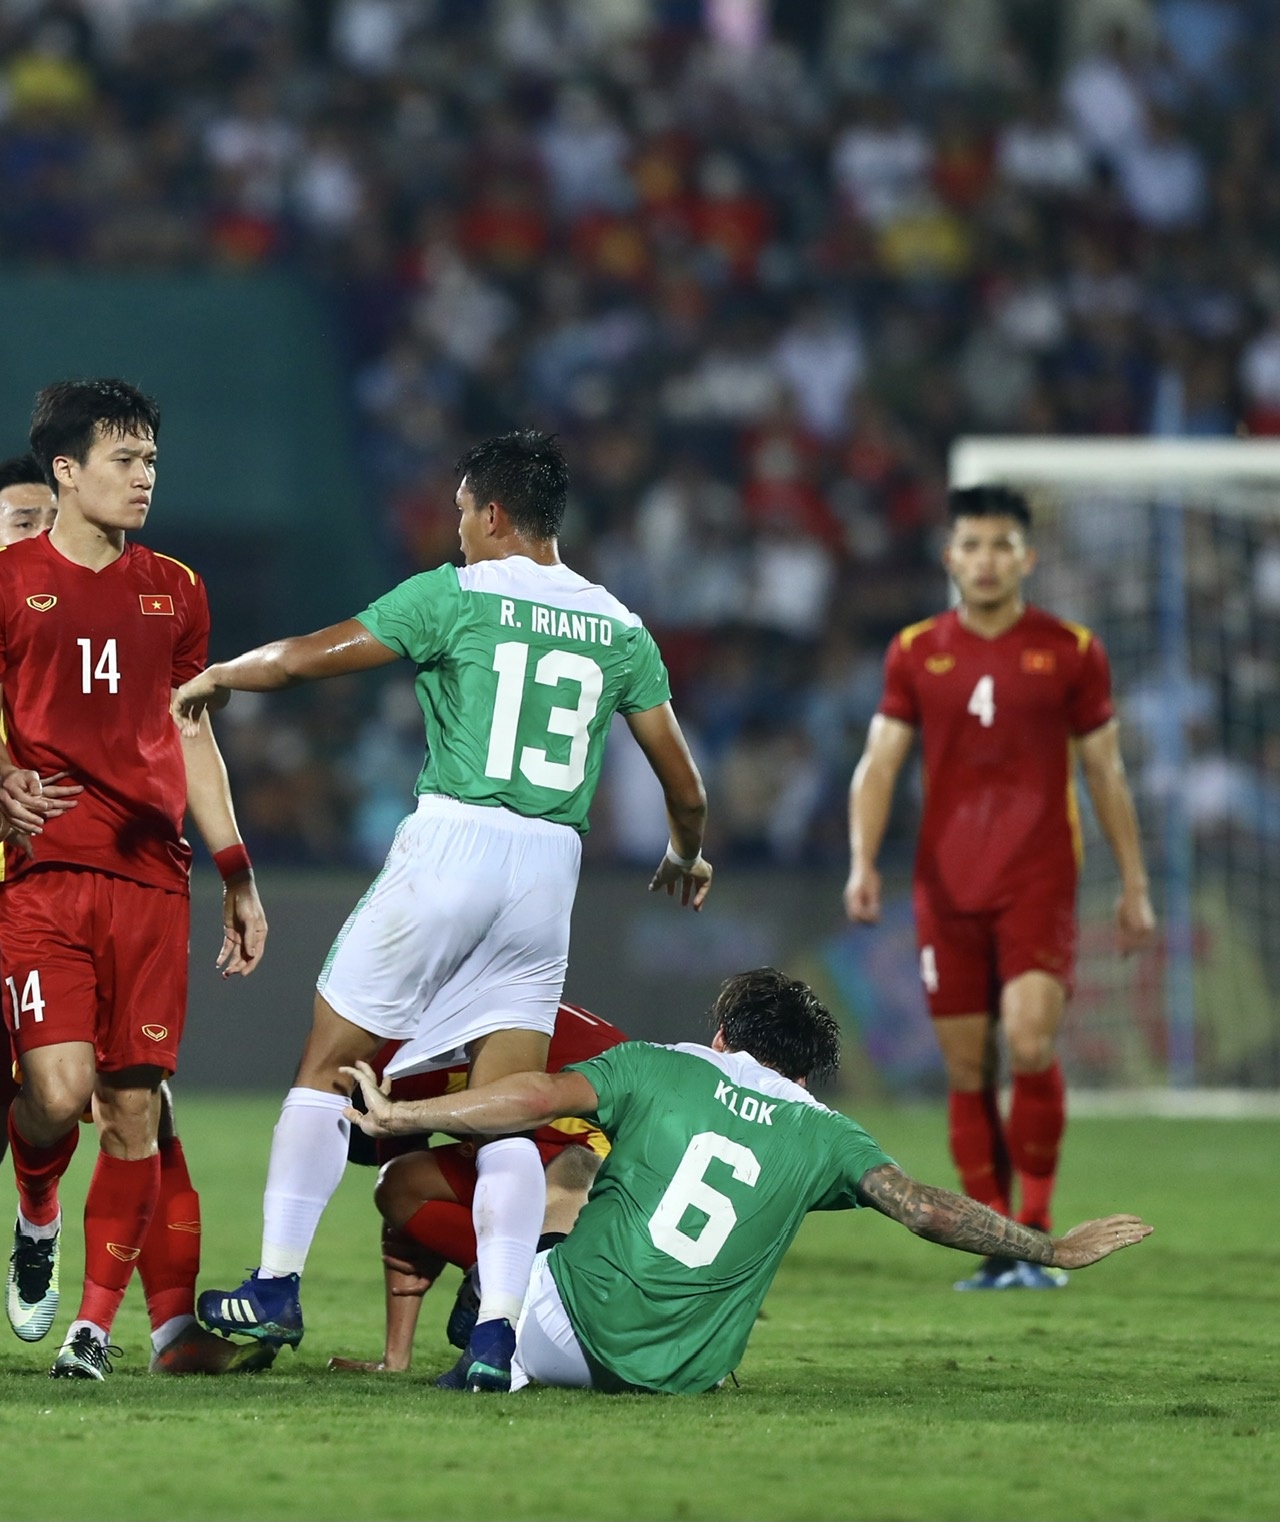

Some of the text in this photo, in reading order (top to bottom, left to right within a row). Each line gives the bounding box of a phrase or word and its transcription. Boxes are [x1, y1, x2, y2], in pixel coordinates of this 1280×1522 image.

[500, 599, 613, 647] R. IRIANTO
[77, 638, 121, 694] 14
[484, 641, 604, 793] 13
[967, 674, 996, 727] 4
[5, 969, 46, 1030] 14
[713, 1079, 777, 1126] KLOK
[647, 1131, 762, 1269] 6
